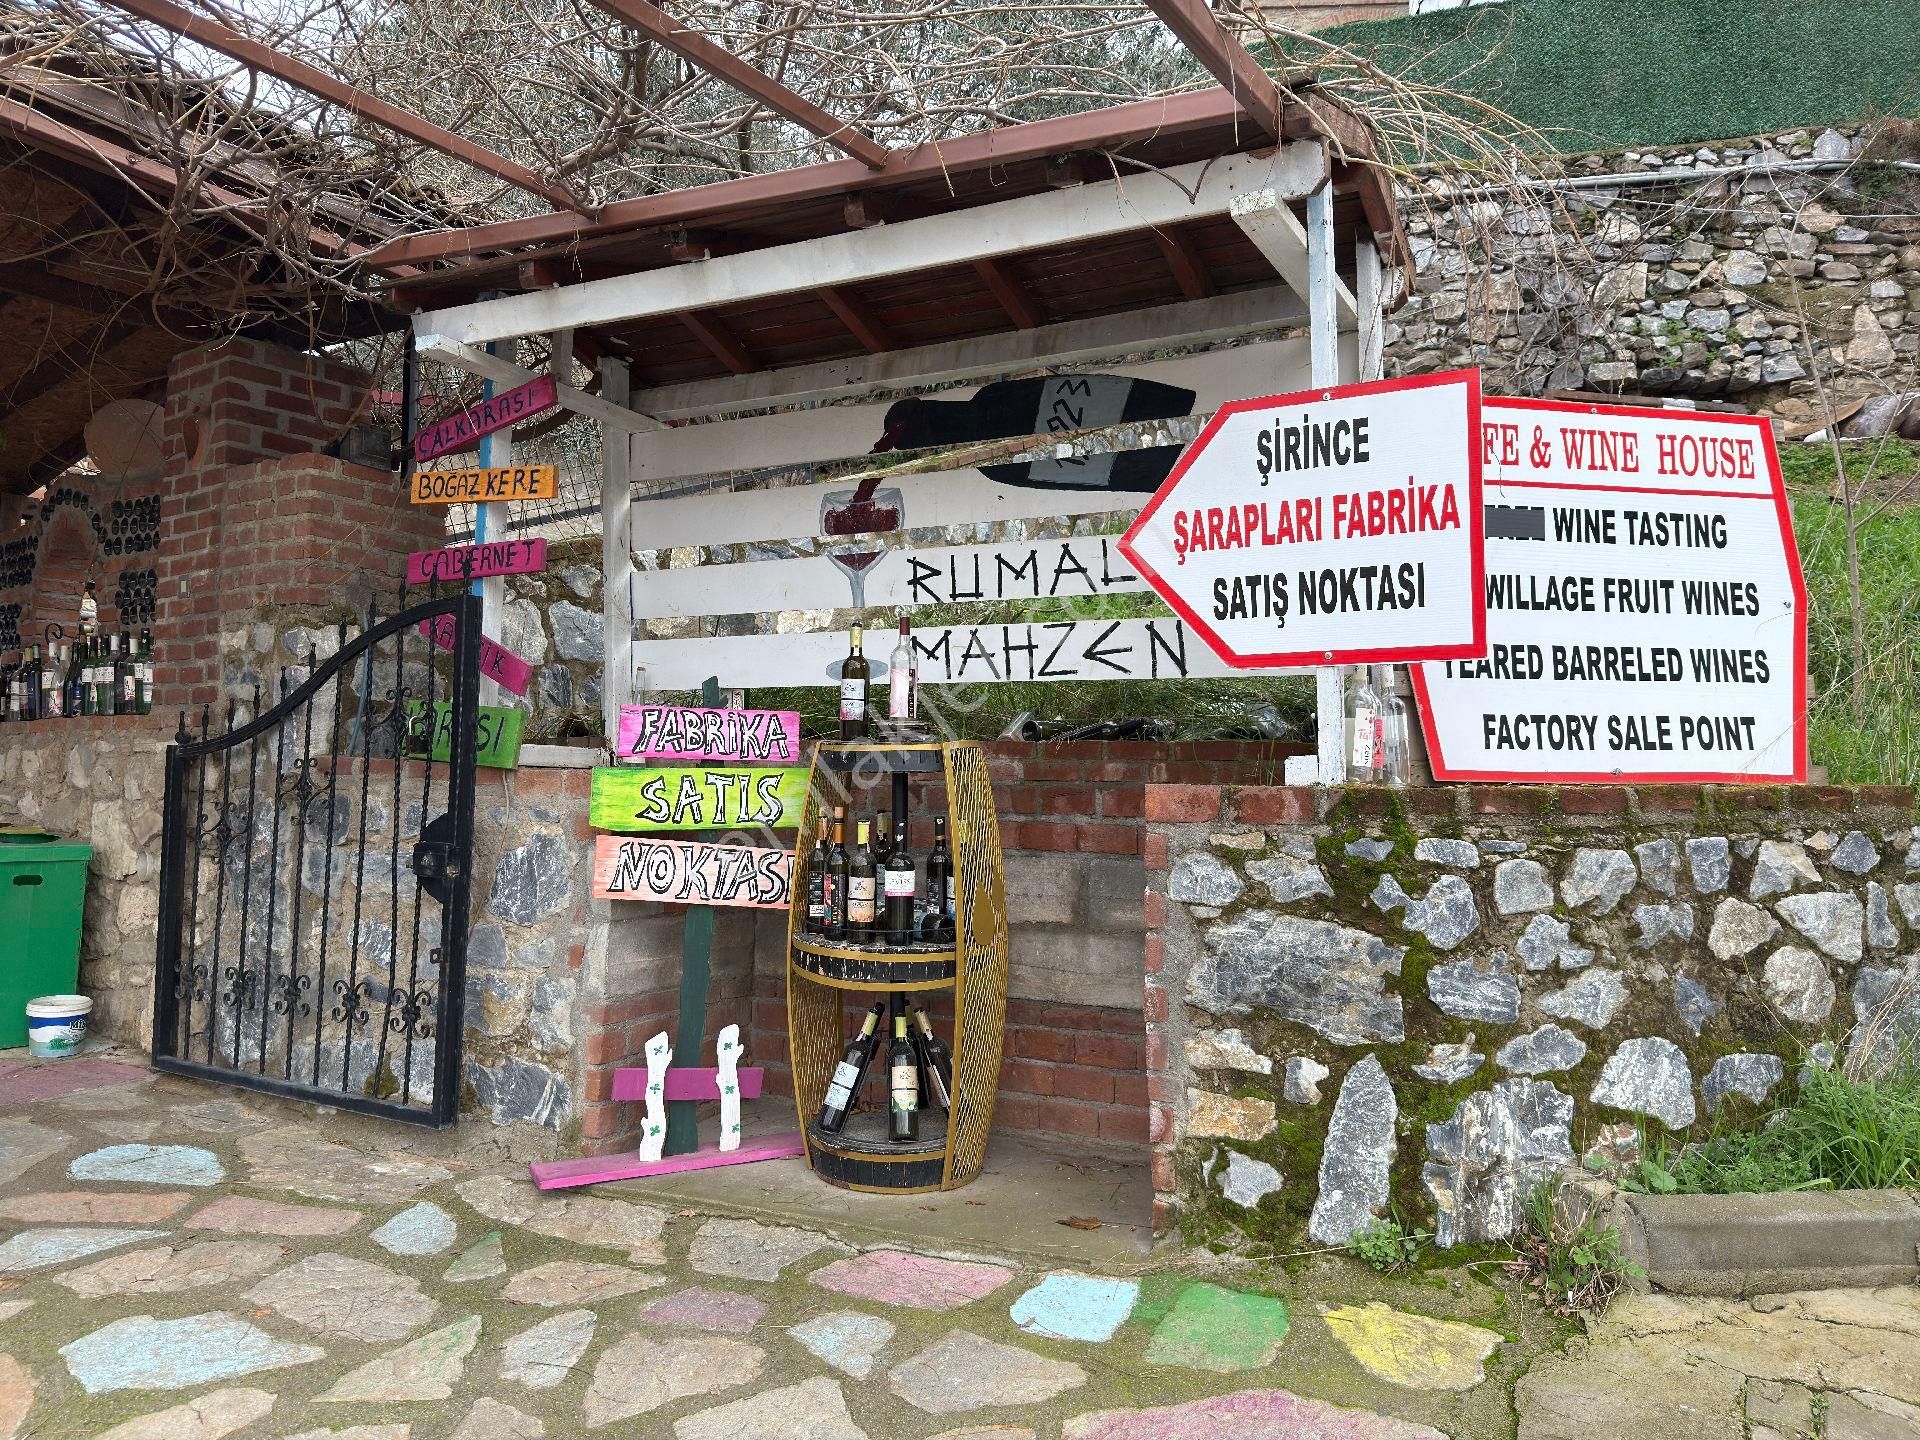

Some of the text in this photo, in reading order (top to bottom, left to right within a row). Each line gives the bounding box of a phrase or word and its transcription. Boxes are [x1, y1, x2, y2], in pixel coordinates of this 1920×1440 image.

[1257, 413, 1369, 486] ŞİRİNCE
[1530, 424, 1551, 468] &
[1560, 427, 1639, 473] WINE
[1657, 433, 1755, 479] HOUSE
[1173, 495, 1322, 566] ŞARAPLARI
[1333, 475, 1461, 540] FABRİKA
[1553, 507, 1617, 544] WINE
[1623, 510, 1728, 549] TASTING
[421, 540, 535, 577] CABERNET
[907, 538, 1138, 602] RUMAL
[1213, 562, 1425, 629] SATIŞ NOKTASI
[1485, 574, 1760, 617] WILLAGE FRUIT WINES
[911, 619, 1188, 680] MAHZEN
[1553, 645, 1683, 682] BARRELED
[1690, 648, 1770, 684] WINES
[1482, 713, 1756, 751] FACTORY SALE POINT
[635, 772, 784, 827] SATIŞ
